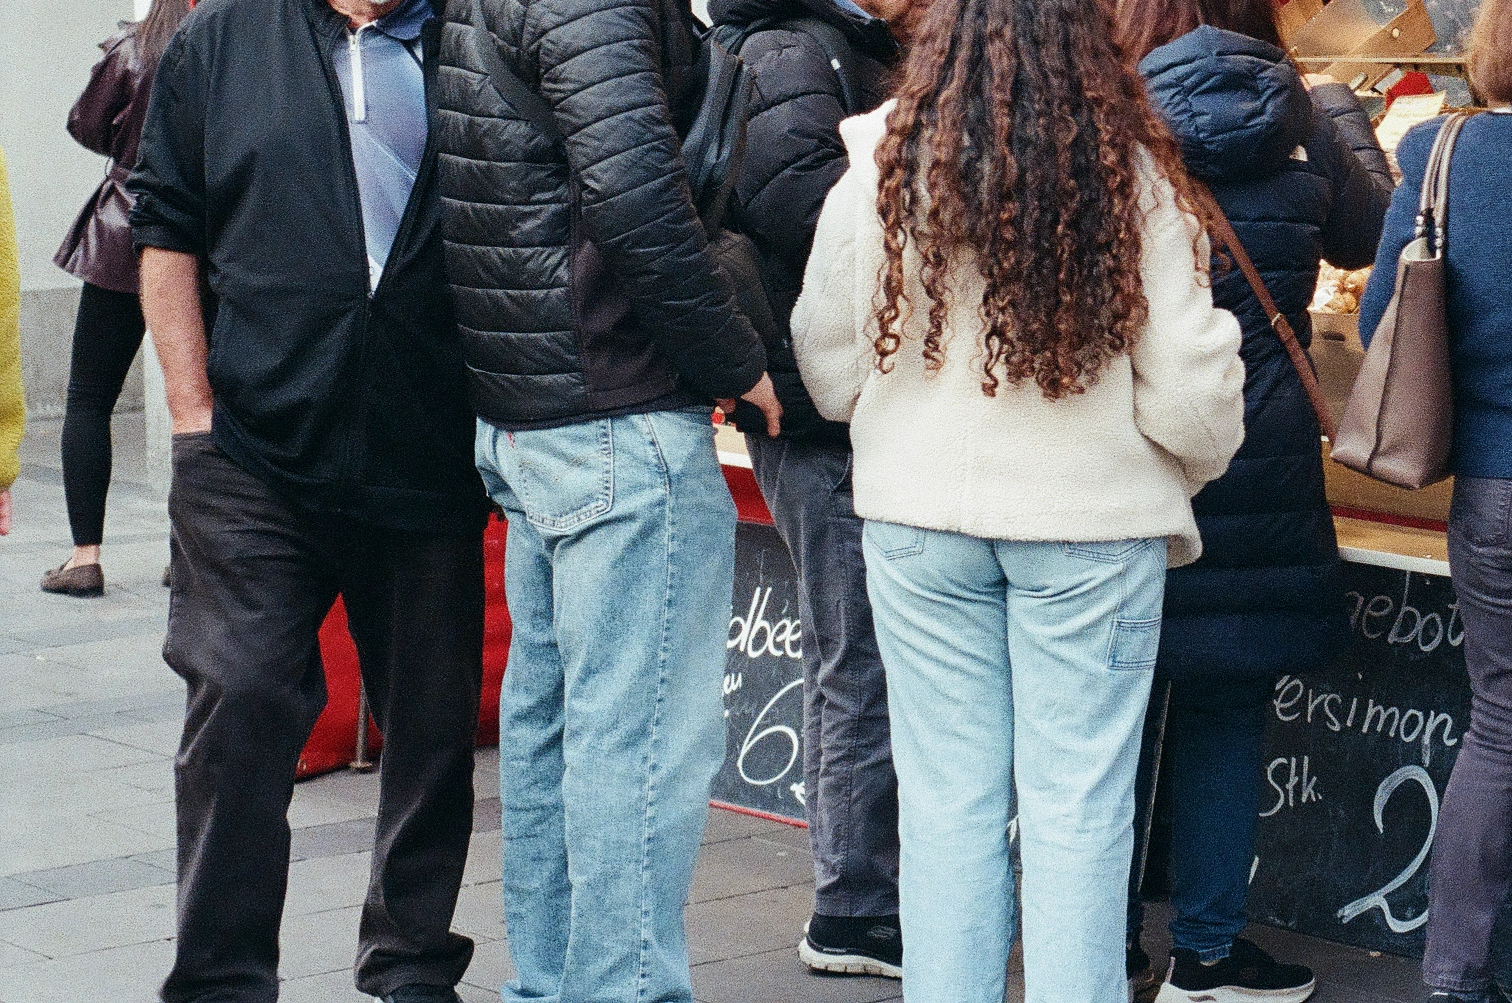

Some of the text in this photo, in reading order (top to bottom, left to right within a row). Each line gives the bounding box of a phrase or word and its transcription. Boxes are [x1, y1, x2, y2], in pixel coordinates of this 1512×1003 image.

[726, 586, 803, 659] dbee
[737, 678, 805, 786] 6
[1273, 672, 1458, 767] ersimon
[1337, 764, 1439, 934] 2
